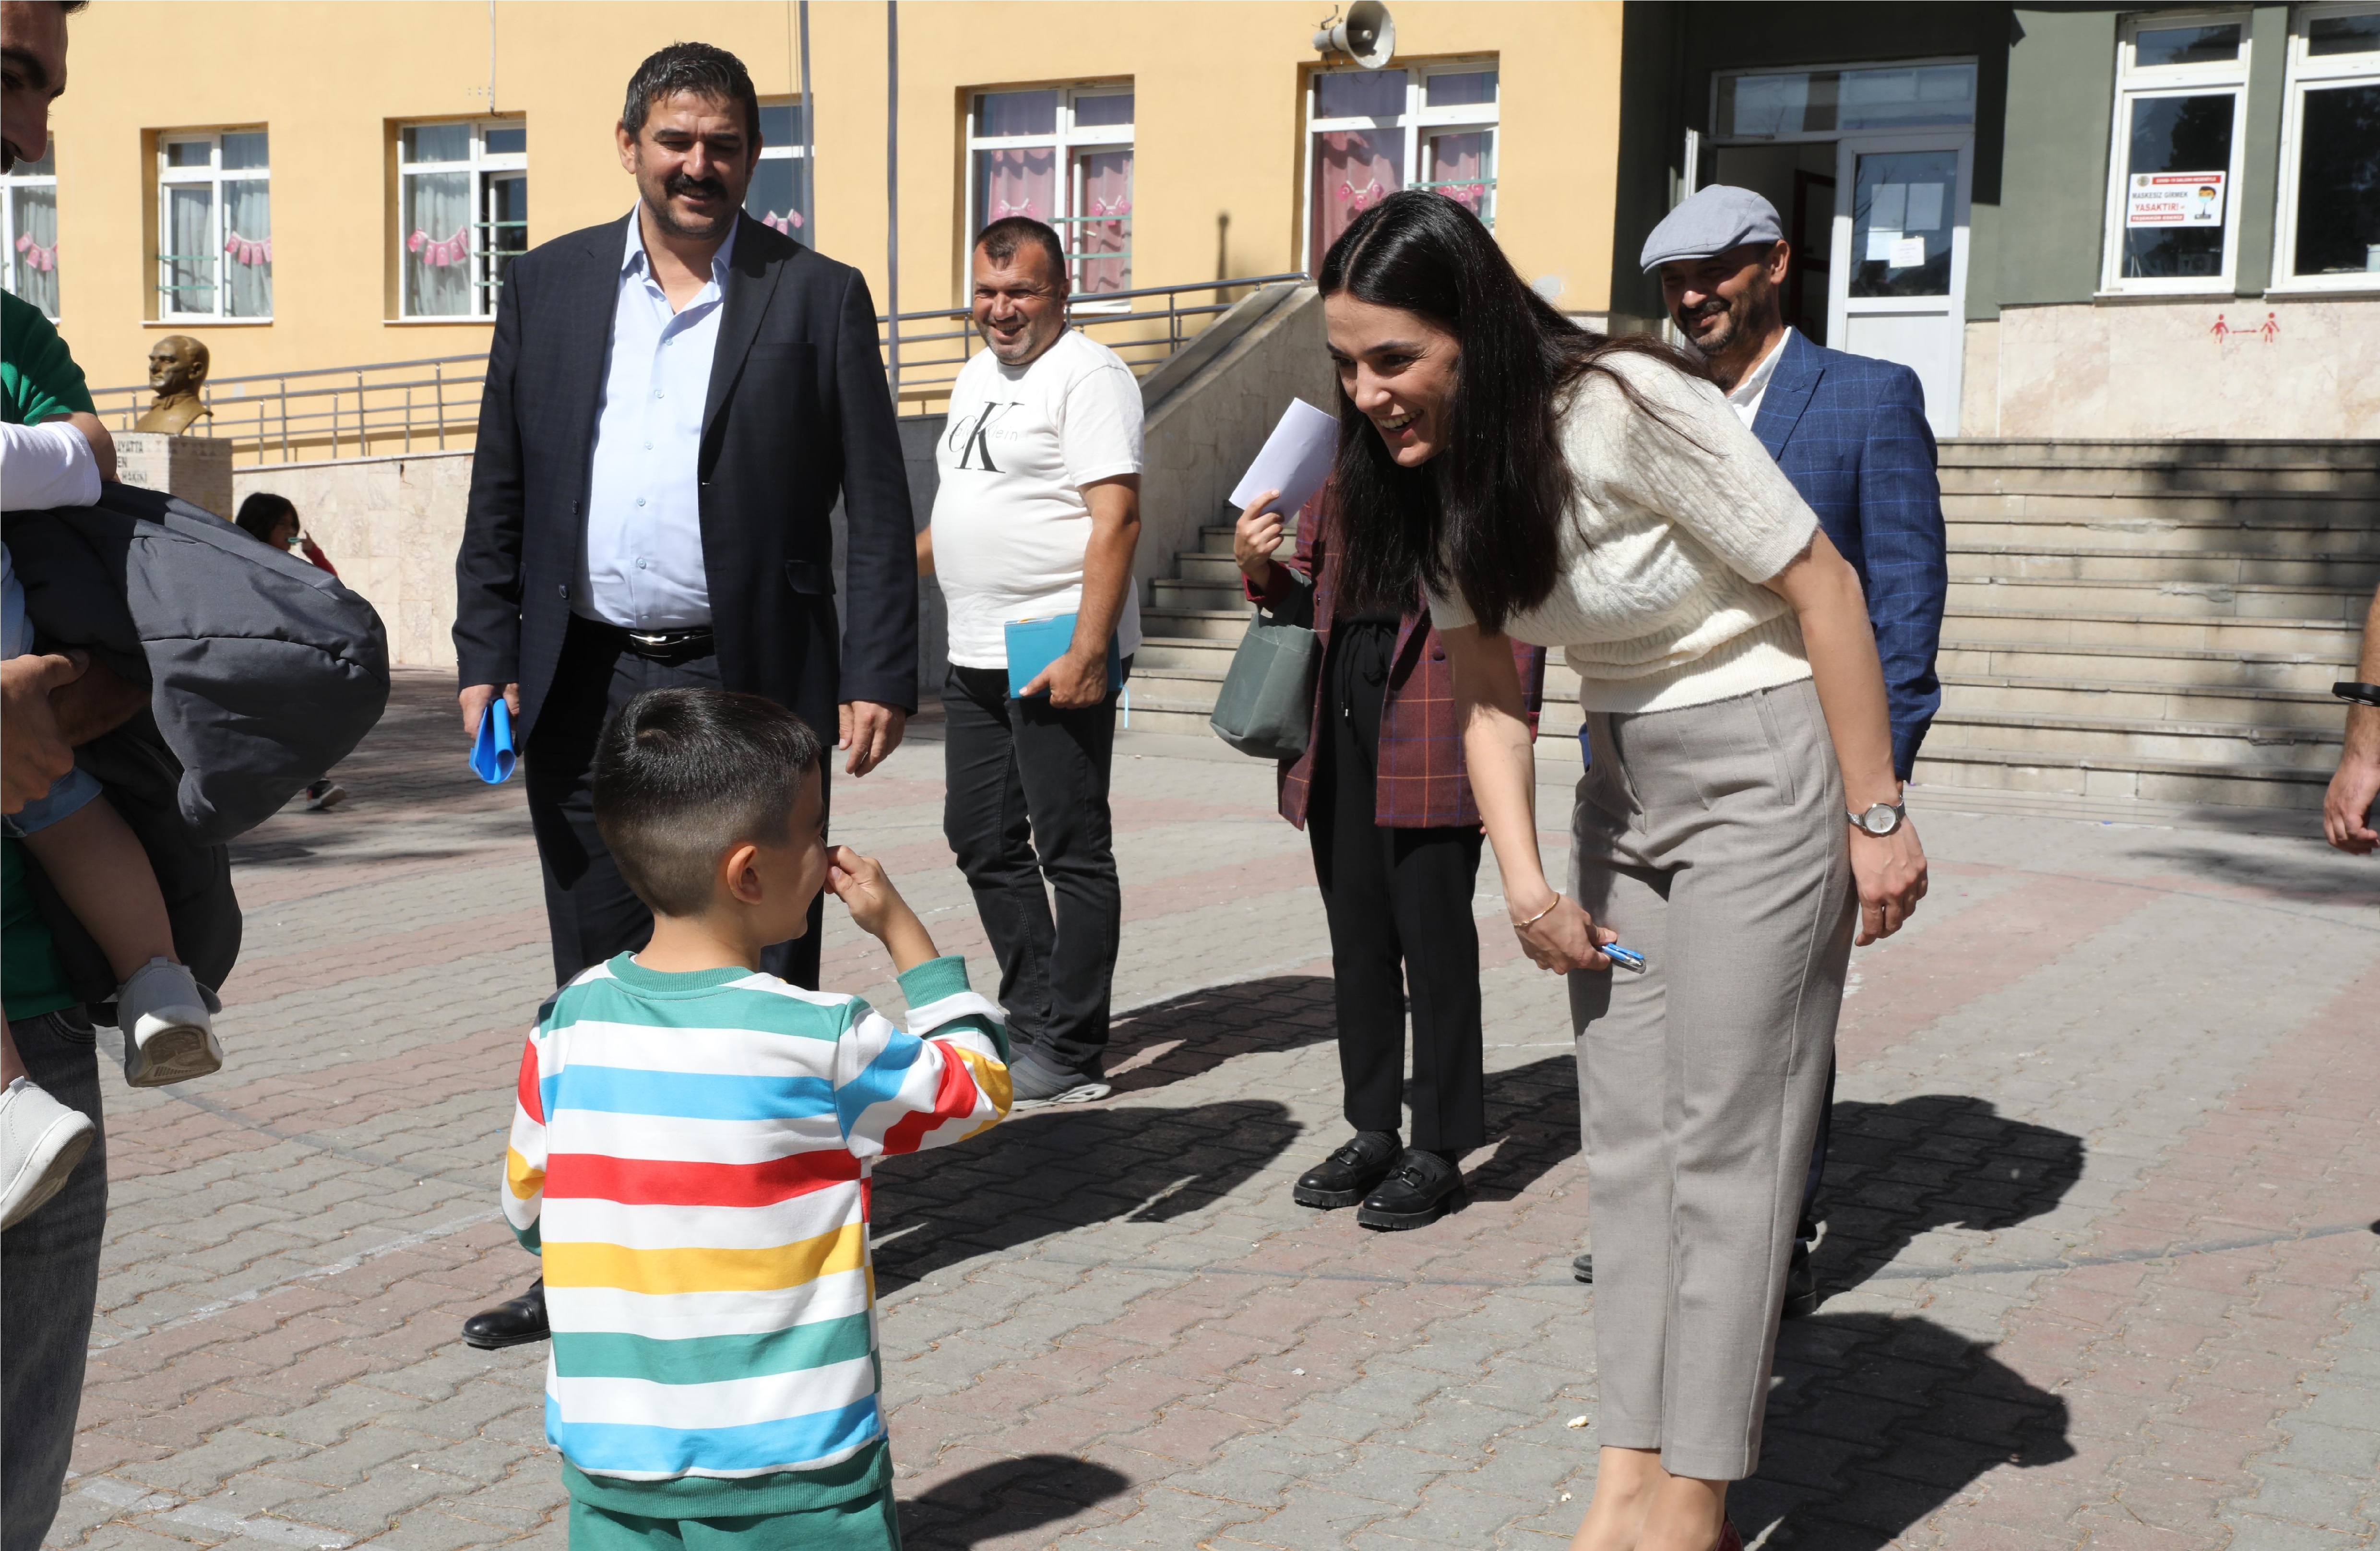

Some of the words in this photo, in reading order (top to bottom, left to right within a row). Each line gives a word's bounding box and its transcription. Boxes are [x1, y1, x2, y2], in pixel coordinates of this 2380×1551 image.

[2164, 190, 2188, 198] GİRMEK
[2135, 203, 2178, 211] YASAKTIR!
[986, 424, 1018, 441] Klein
